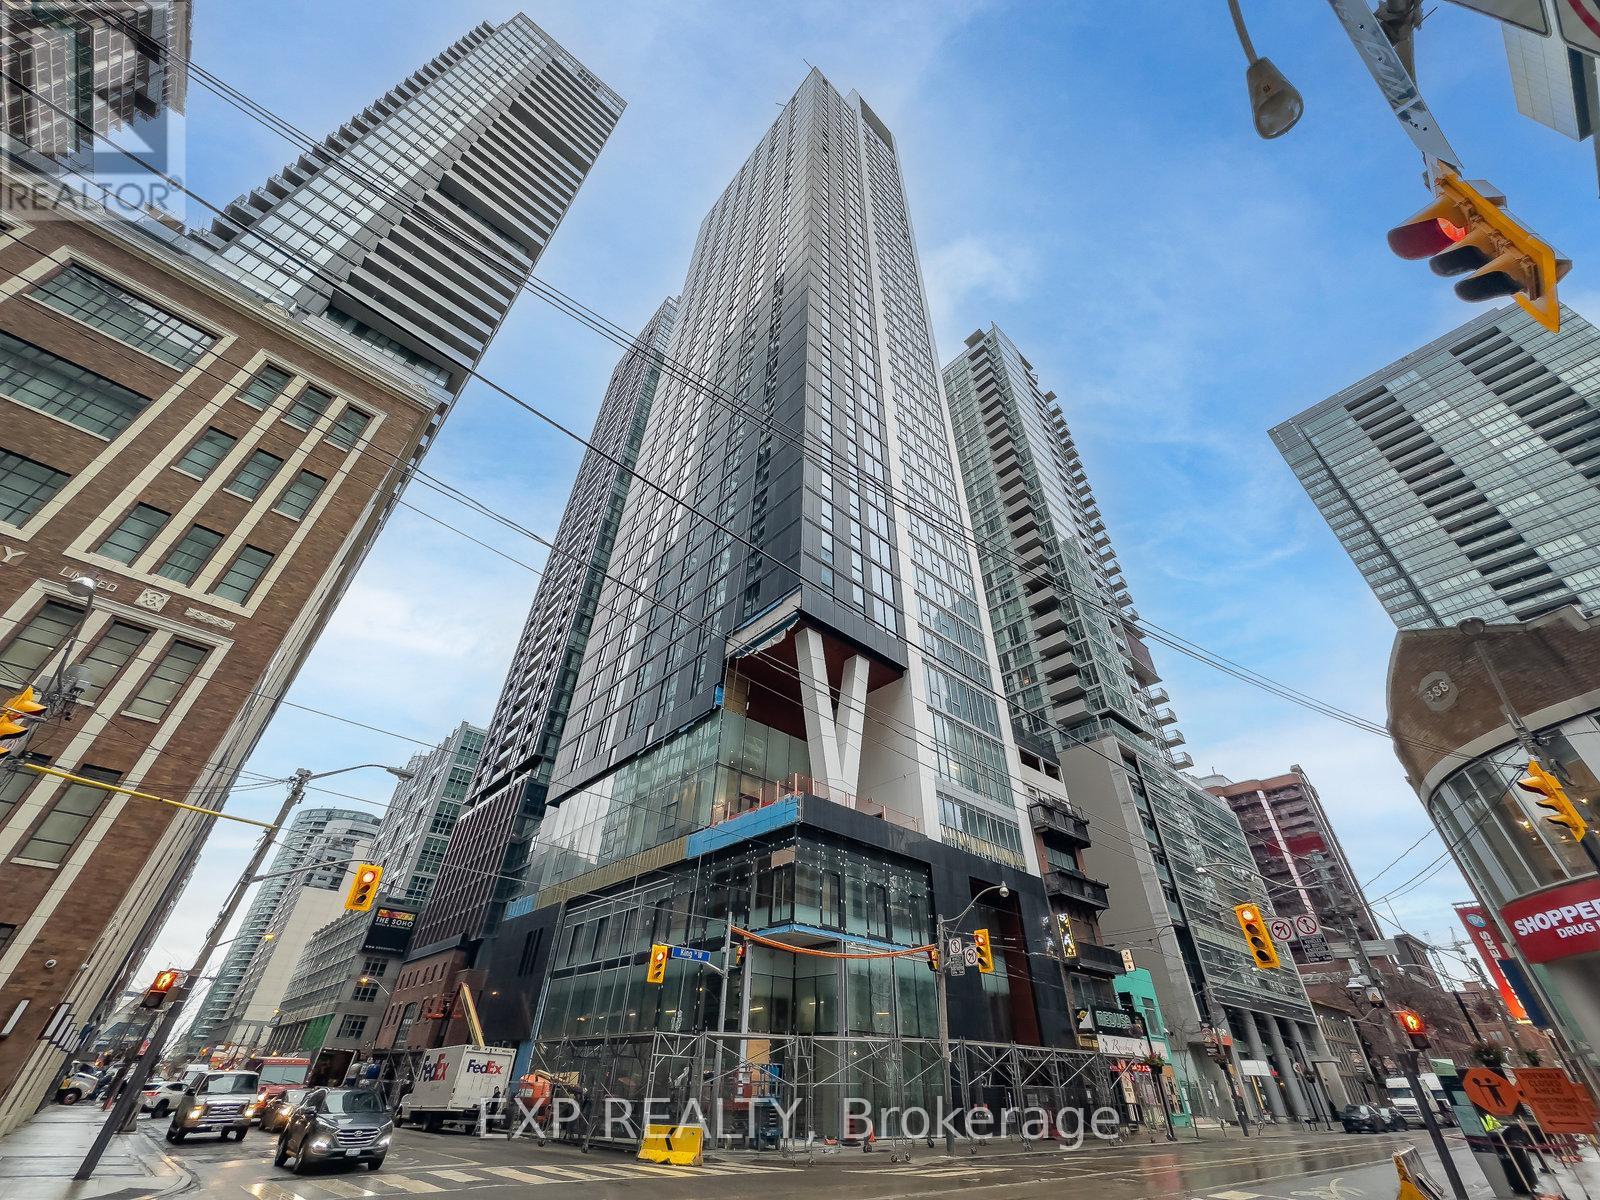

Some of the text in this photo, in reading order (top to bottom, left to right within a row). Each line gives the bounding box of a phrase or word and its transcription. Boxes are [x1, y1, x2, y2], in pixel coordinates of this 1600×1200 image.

[1425, 681, 1450, 702] 388
[376, 916, 389, 924] THE
[392, 918, 414, 928] SOHO
[1556, 922, 1596, 939] DRUG
[422, 1053, 450, 1081] FedEx
[466, 1058, 504, 1075] FedEx
